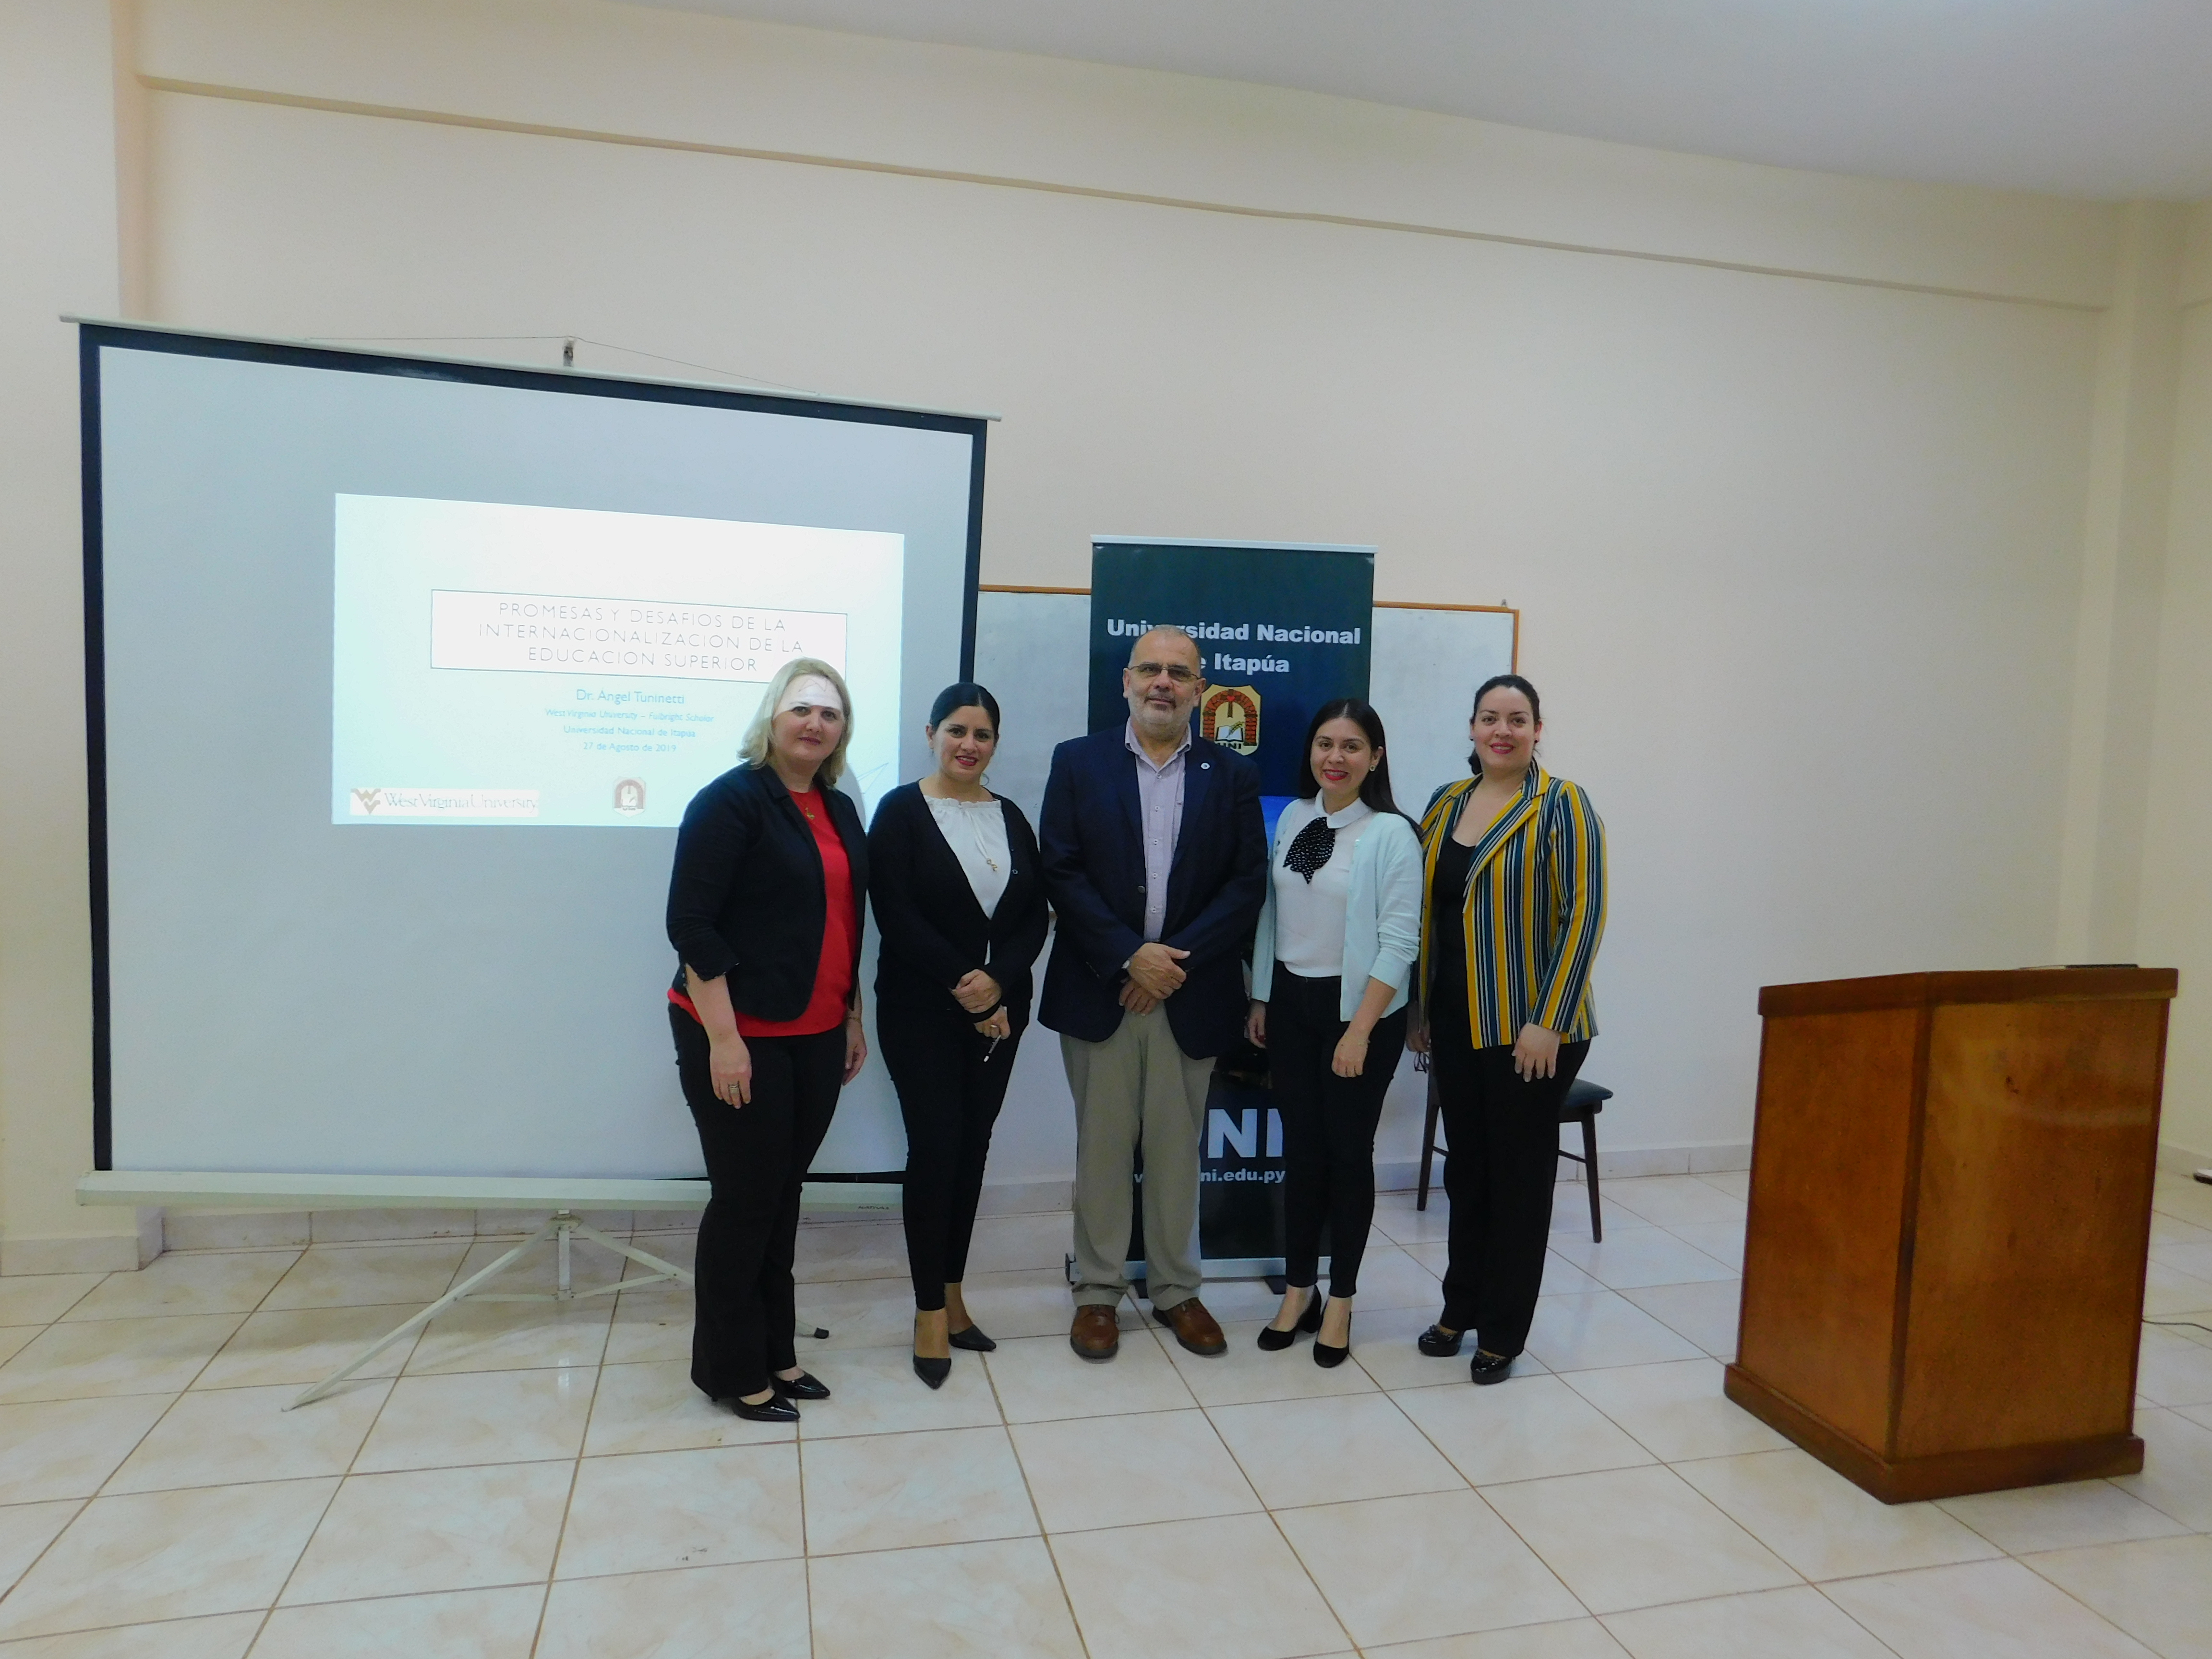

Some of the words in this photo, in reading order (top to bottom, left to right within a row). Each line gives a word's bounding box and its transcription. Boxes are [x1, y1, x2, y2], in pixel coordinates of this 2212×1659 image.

[499, 602, 602, 620] PROMESAS
[611, 609, 619, 621] Y
[630, 609, 721, 627] DESAFIOS
[732, 616, 755, 629] DE
[765, 618, 785, 631] LA
[480, 624, 739, 649] INTERNACIONALIZACION
[749, 637, 772, 651] DE
[782, 639, 803, 653] LA
[1107, 618, 1250, 640] Unisidad
[1257, 624, 1360, 644] Nacional
[529, 647, 654, 665] EDUCACION
[664, 653, 757, 672] SUPERIOR
[1214, 653, 1290, 675] Itapúa
[577, 689, 594, 700] Dr.
[634, 691, 685, 704] Tuninetti
[563, 725, 614, 734] Universidad
[617, 727, 655, 736] Nacional
[583, 742, 594, 750] 27
[596, 742, 607, 750] de
[608, 743, 639, 753] Agosto
[656, 744, 676, 752] 2019
[384, 792, 419, 808] West
[418, 793, 469, 809] Virginia
[470, 794, 537, 814] University
[1208, 1108, 1283, 1159] NI
